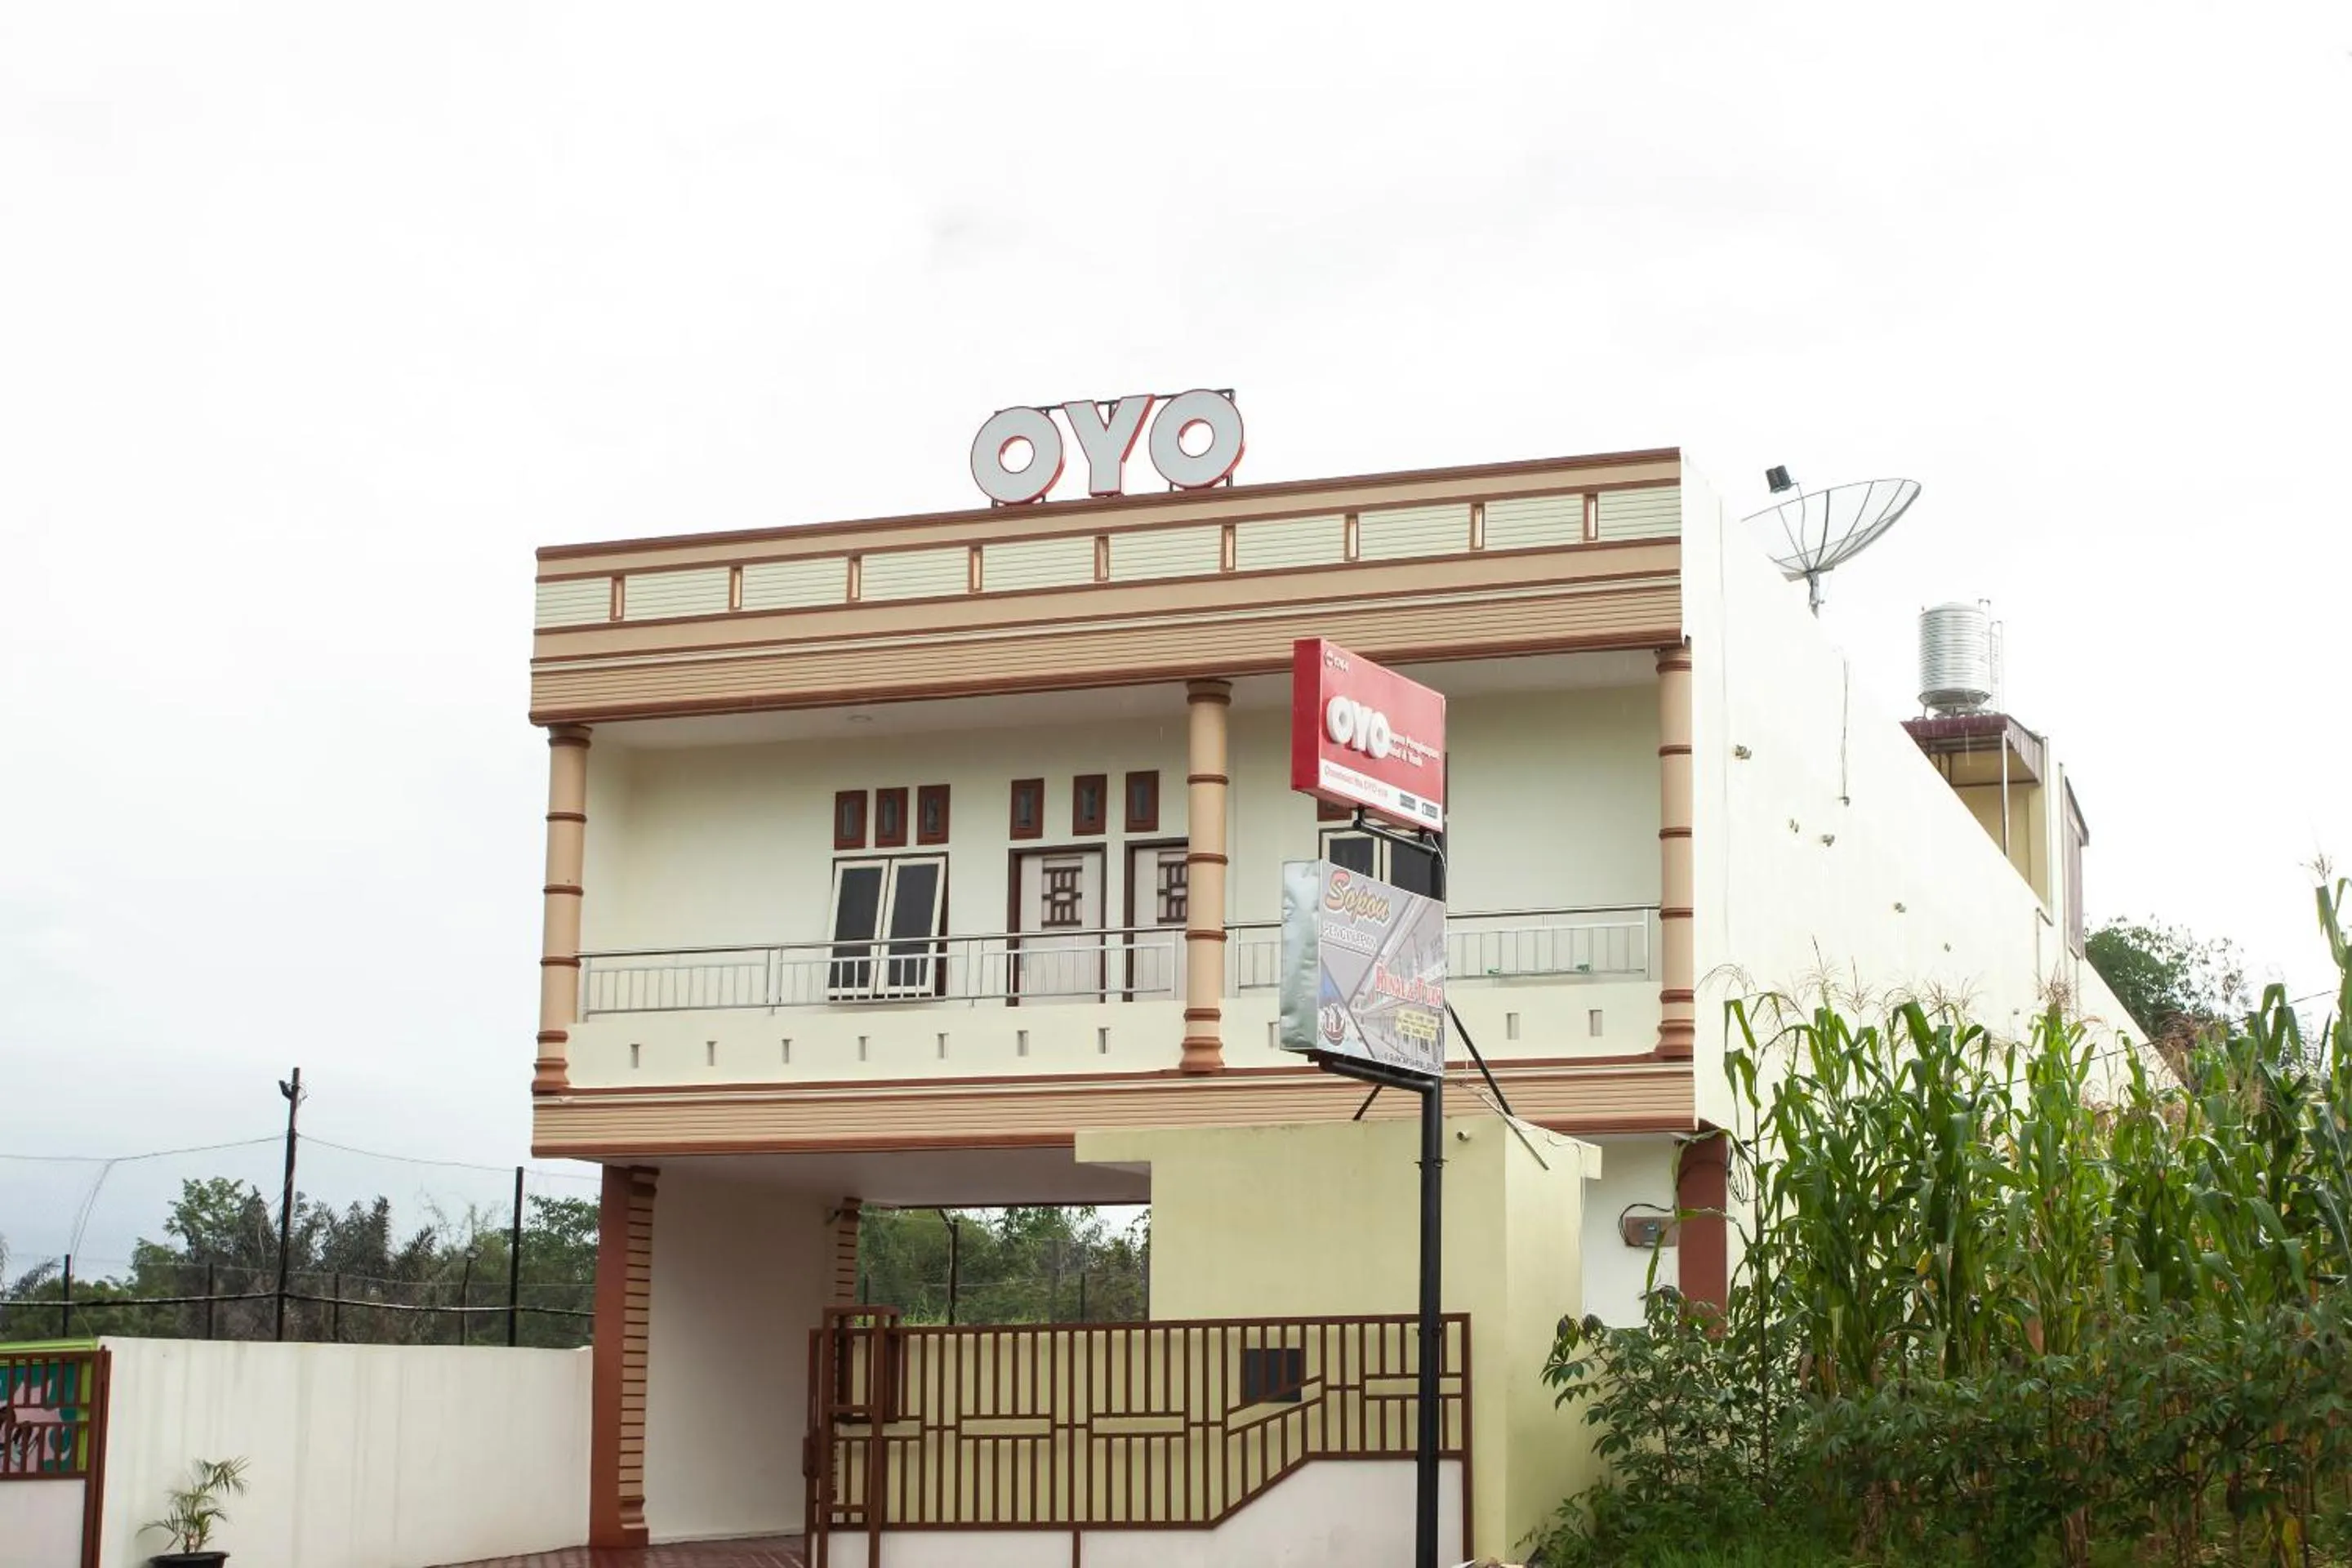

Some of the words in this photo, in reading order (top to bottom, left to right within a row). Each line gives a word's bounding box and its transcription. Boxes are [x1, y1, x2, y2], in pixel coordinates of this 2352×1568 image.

[970, 389, 1245, 506] OYO
[1326, 696, 1389, 759] OYO
[1325, 869, 1390, 924] Sopou
